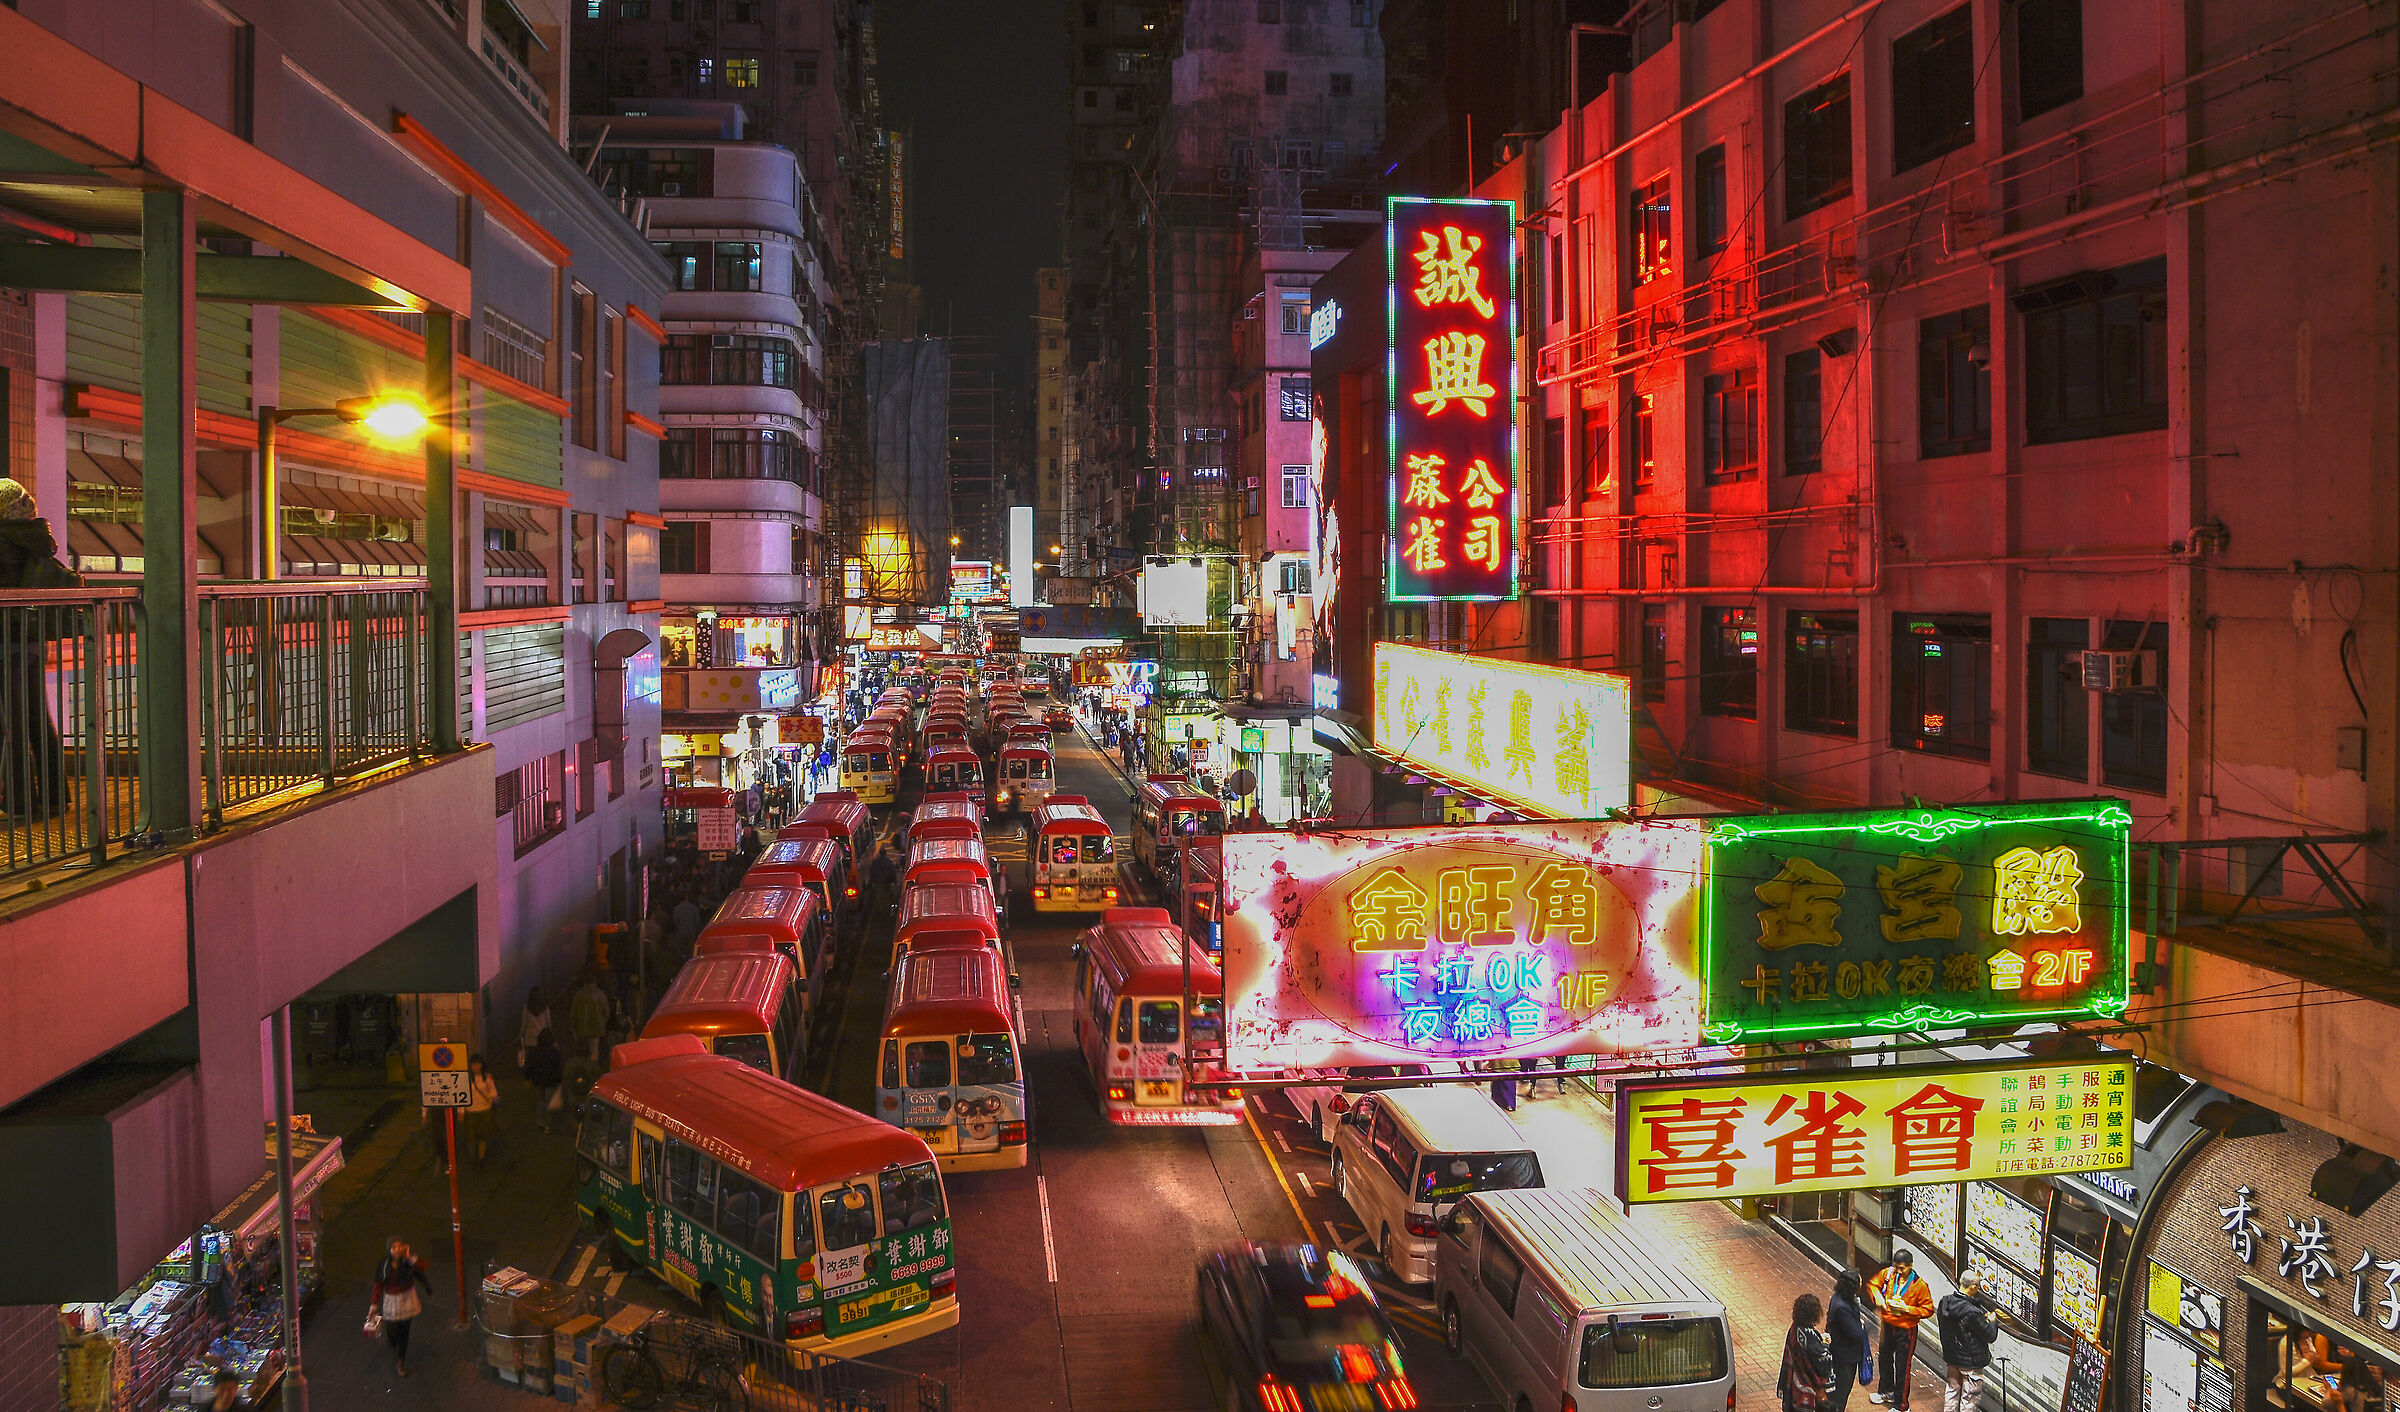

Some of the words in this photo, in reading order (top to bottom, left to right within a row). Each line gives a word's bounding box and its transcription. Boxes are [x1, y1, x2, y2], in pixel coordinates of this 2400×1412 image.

[1412, 226, 1495, 417] 誠興
[1460, 459, 1504, 572] 公司
[1111, 684, 1154, 695] SALON
[1350, 862, 1599, 953] 金旺角
[2030, 948, 2093, 988] 2/F
[1555, 971, 1610, 1011] 1/F
[1400, 1000, 1545, 1045] 夜總會
[452, 1091, 468, 1103] 12
[630, 1099, 644, 1113] LIGHT
[645, 1107, 655, 1120] BUS
[664, 1117, 681, 1132] SEATS
[1998, 1076, 2018, 1155] 聯誼會所
[2054, 1073, 2074, 1152] 手動電動
[2080, 1071, 2100, 1150] 服務周到
[2106, 1069, 2125, 1148] 通宵營業
[1637, 1082, 1985, 1194] 喜雀會
[826, 1255, 860, 1274] 改名契
[885, 1227, 949, 1266] 葉謝鄧
[835, 1270, 853, 1281] $500
[891, 1263, 918, 1281] 6639
[920, 1253, 946, 1273] 9999
[842, 1308, 868, 1321] 3891
